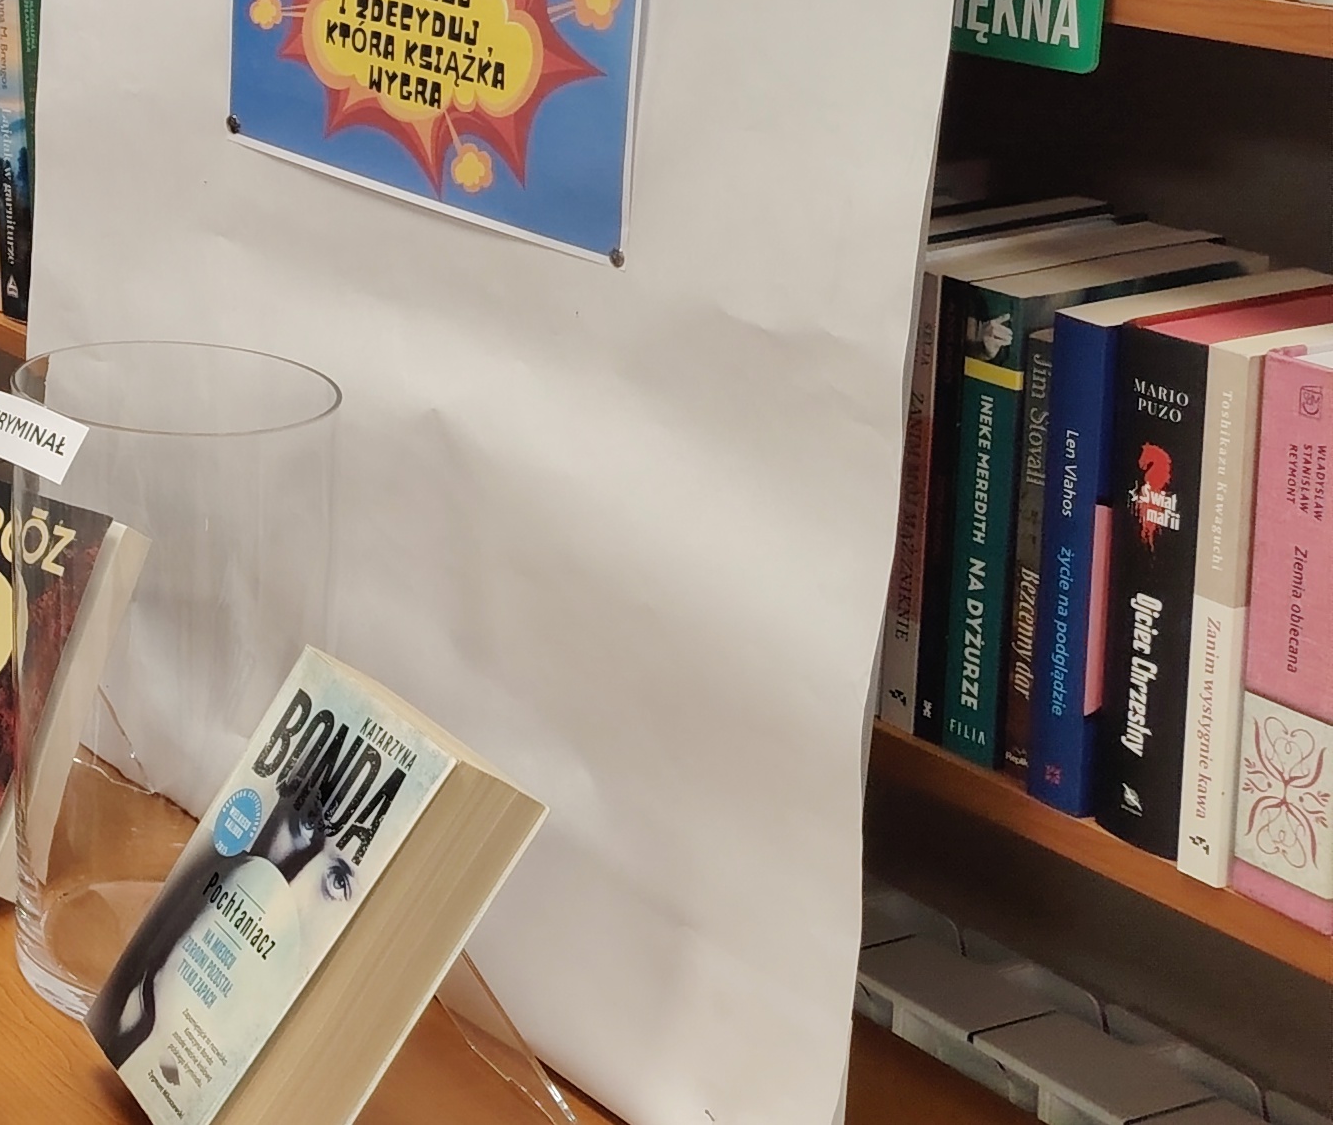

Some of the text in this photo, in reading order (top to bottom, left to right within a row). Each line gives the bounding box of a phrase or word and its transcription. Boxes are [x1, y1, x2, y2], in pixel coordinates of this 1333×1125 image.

[0, 26, 7, 40] M.
[326, 19, 505, 90] KTÓRA KSIĄŻKA
[369, 65, 441, 109] WYGRA
[1030, 353, 1053, 400] Jim
[1134, 377, 1189, 407] MARIO
[1138, 397, 1182, 423] PUZO
[971, 395, 995, 544] INEKE MEREDITH
[1061, 430, 1079, 518] Len Vlahos
[1210, 390, 1234, 572] Toshikazu Kawaguchi
[1285, 443, 1299, 506] REYMONT
[1146, 508, 1181, 531] mafii
[960, 557, 987, 711] NA DYŻURZE
[1011, 568, 1041, 700] Bezcenny dar
[1050, 546, 1075, 717] życie na podglądzie
[1286, 545, 1309, 674] Ziemia obiecana
[1120, 592, 1164, 758] Ojciec Chrzestny
[359, 716, 418, 772] KATARZYNA
[950, 718, 985, 745] FILIA
[1195, 616, 1222, 820] Zanim wystygnie kawa
[252, 687, 407, 866] BONDA
[202, 871, 276, 961] Pochłaniacz
[202, 928, 237, 971] NA MIEJSCU
[177, 958, 218, 1009] TYLKO ZAPACH
[182, 935, 233, 998] ZBRODNI POZOSTAŁ
